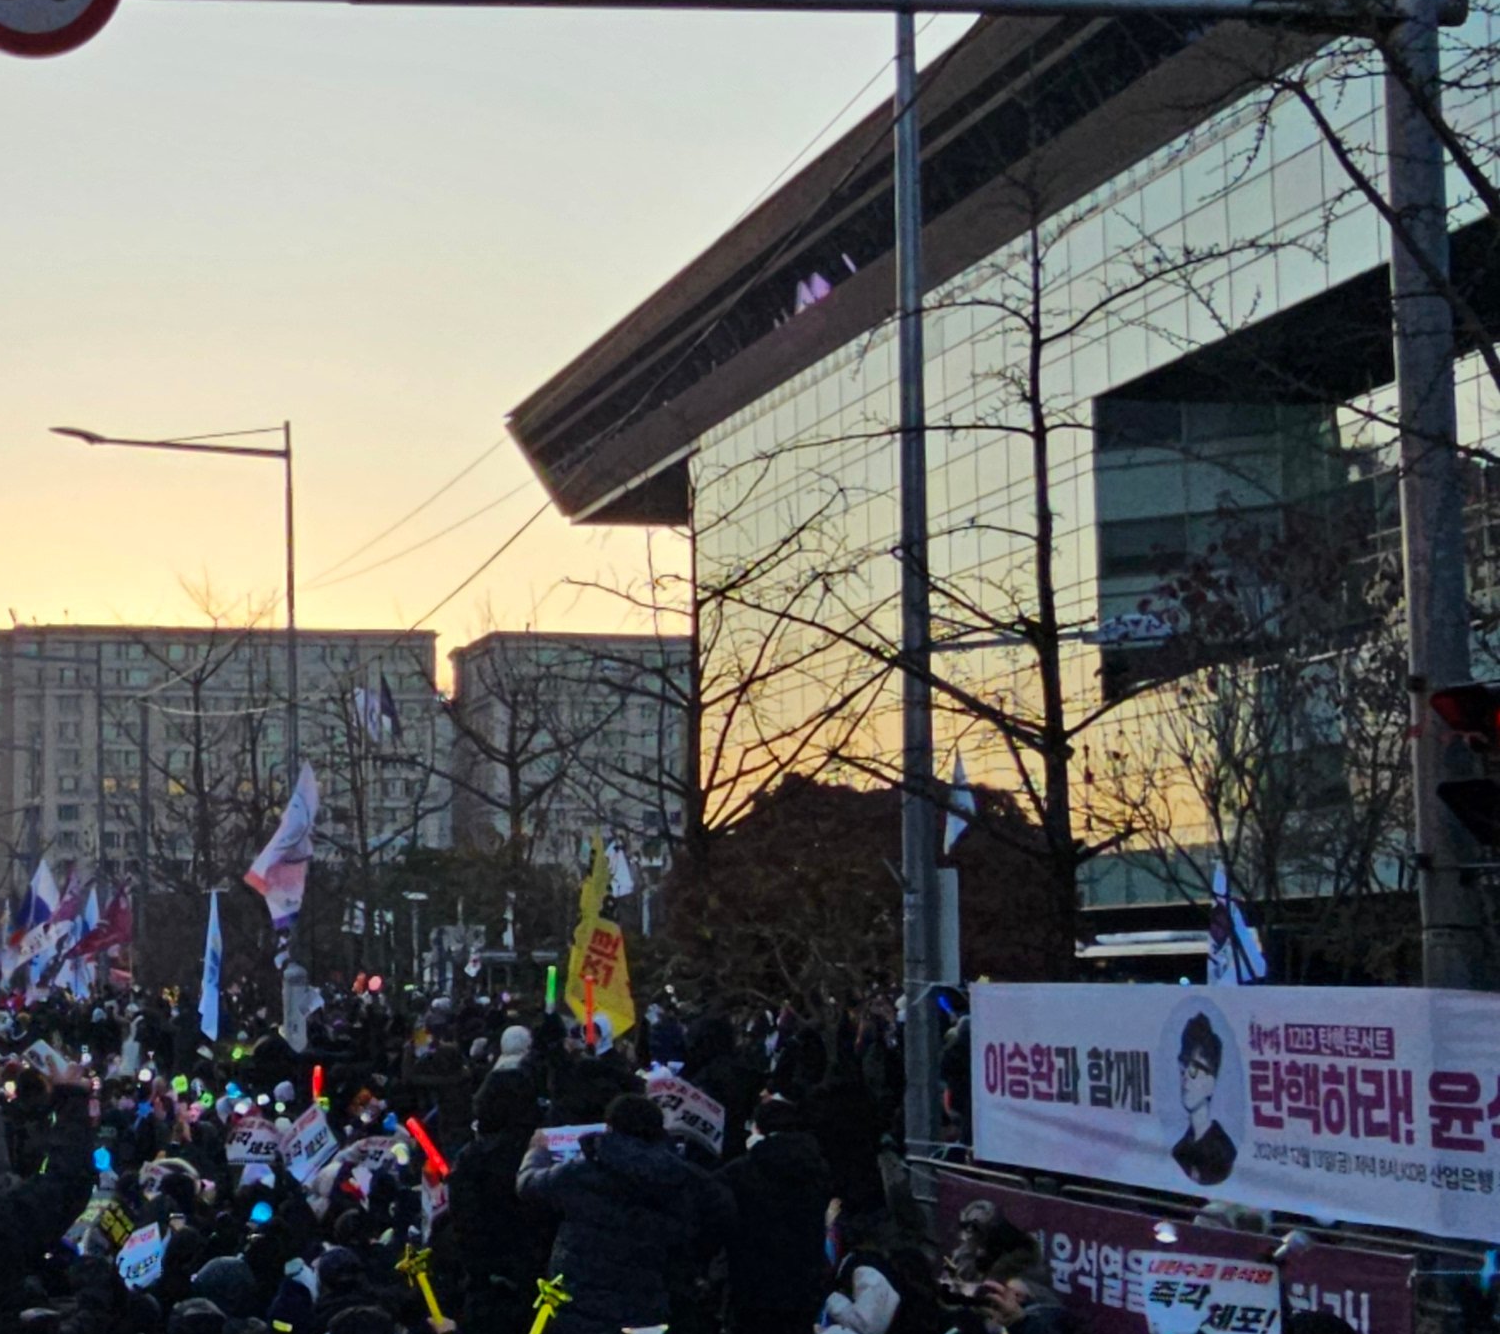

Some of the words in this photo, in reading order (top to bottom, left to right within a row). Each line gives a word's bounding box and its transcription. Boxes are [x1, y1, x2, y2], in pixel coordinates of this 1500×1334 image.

[984, 1042, 1080, 1105] 이승환과
[1086, 1046, 1152, 1113] 함께!
[1249, 1059, 1415, 1146] 탄핵하라!
[1428, 1070, 1500, 1153] 윤
[1430, 1161, 1496, 1196] 산업은행
[1149, 1279, 1212, 1311] 즉각
